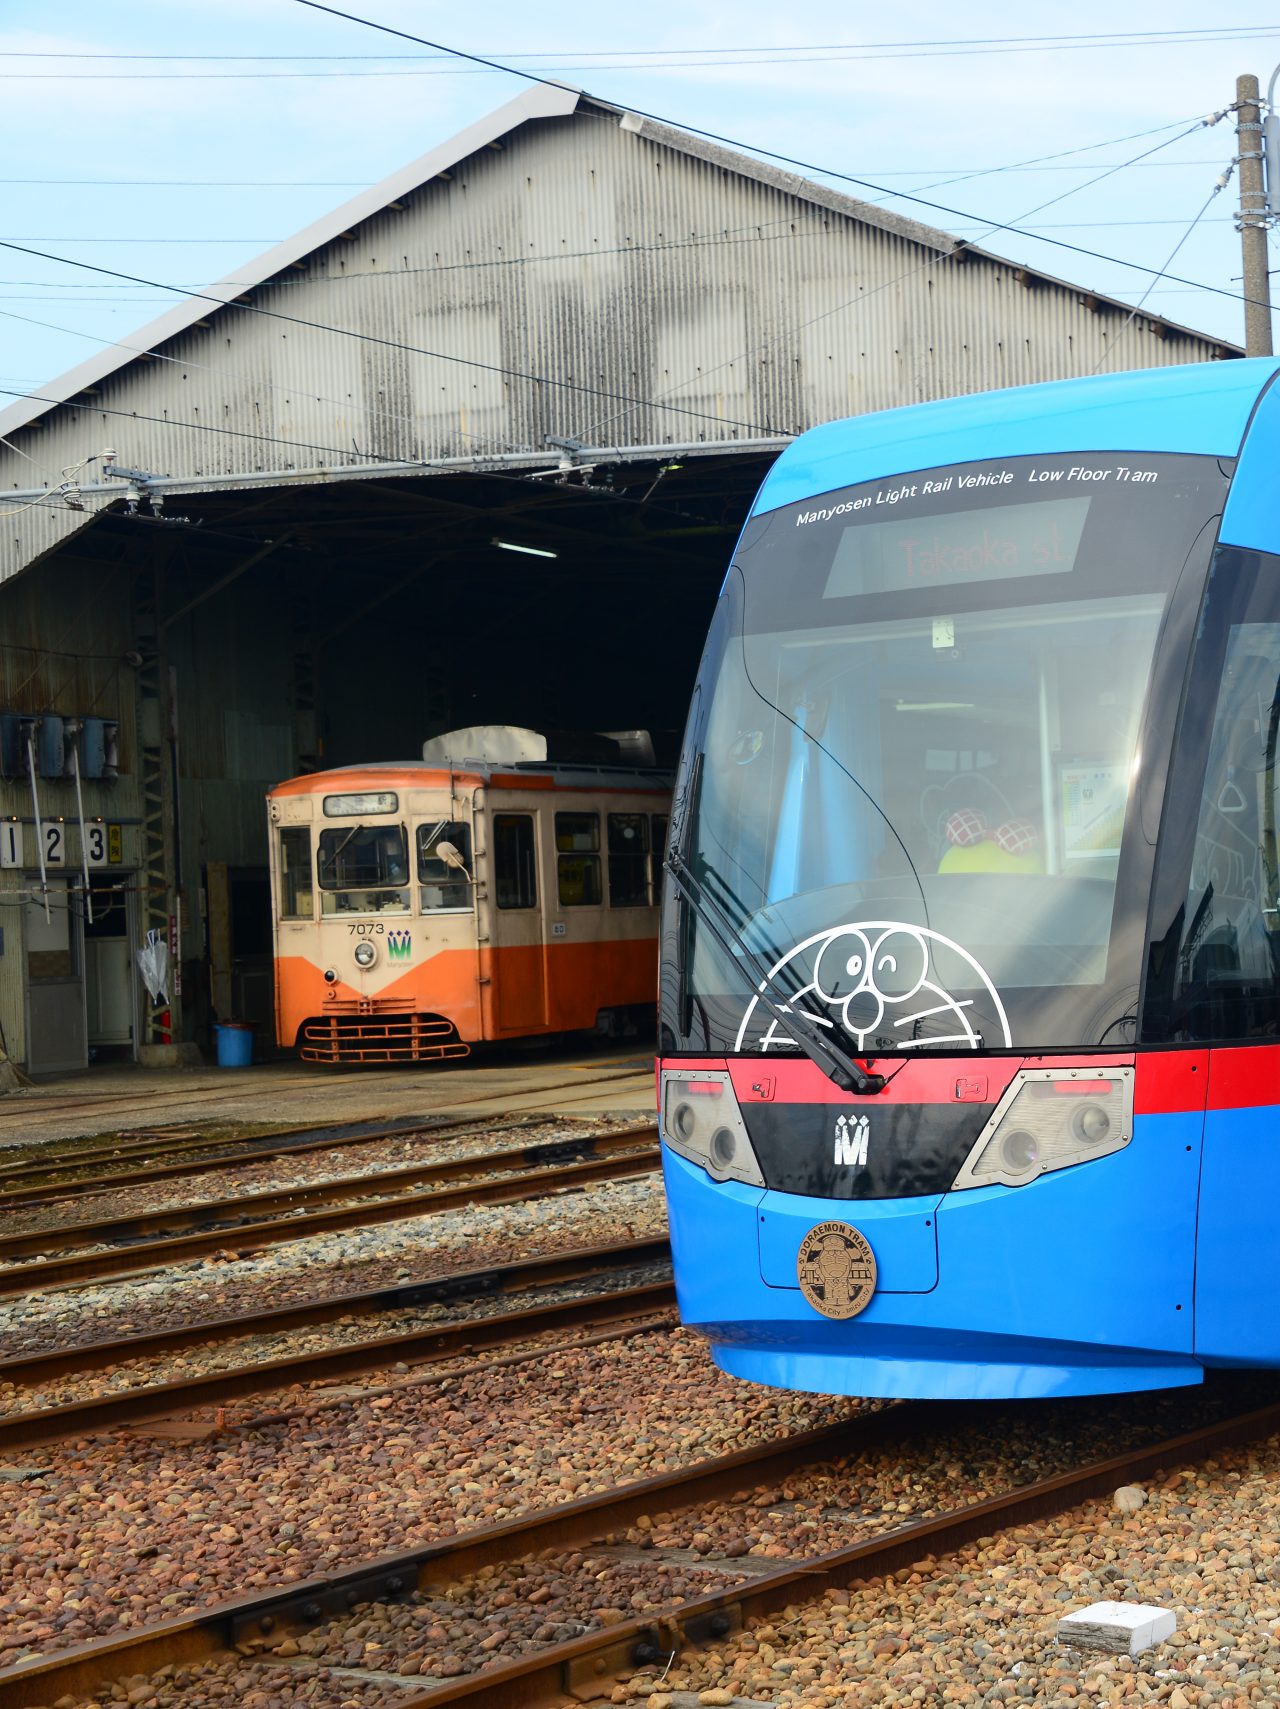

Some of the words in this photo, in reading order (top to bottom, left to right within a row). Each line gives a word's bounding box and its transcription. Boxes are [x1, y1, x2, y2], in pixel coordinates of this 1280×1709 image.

[796, 497, 871, 527] Manyosen
[876, 485, 918, 504] Light
[922, 477, 953, 495] Rail
[958, 470, 1014, 489] Vehicle
[1028, 469, 1065, 483] Low
[1067, 467, 1112, 482] Floor
[1115, 467, 1159, 483] Tram
[898, 528, 1020, 577] Takaoka
[9, 827, 16, 863] 1
[47, 828, 61, 862] 2
[90, 828, 104, 861] 3
[347, 923, 384, 935] 7073
[800, 1223, 846, 1256] DORAEMON
[848, 1228, 870, 1257] TRAM
